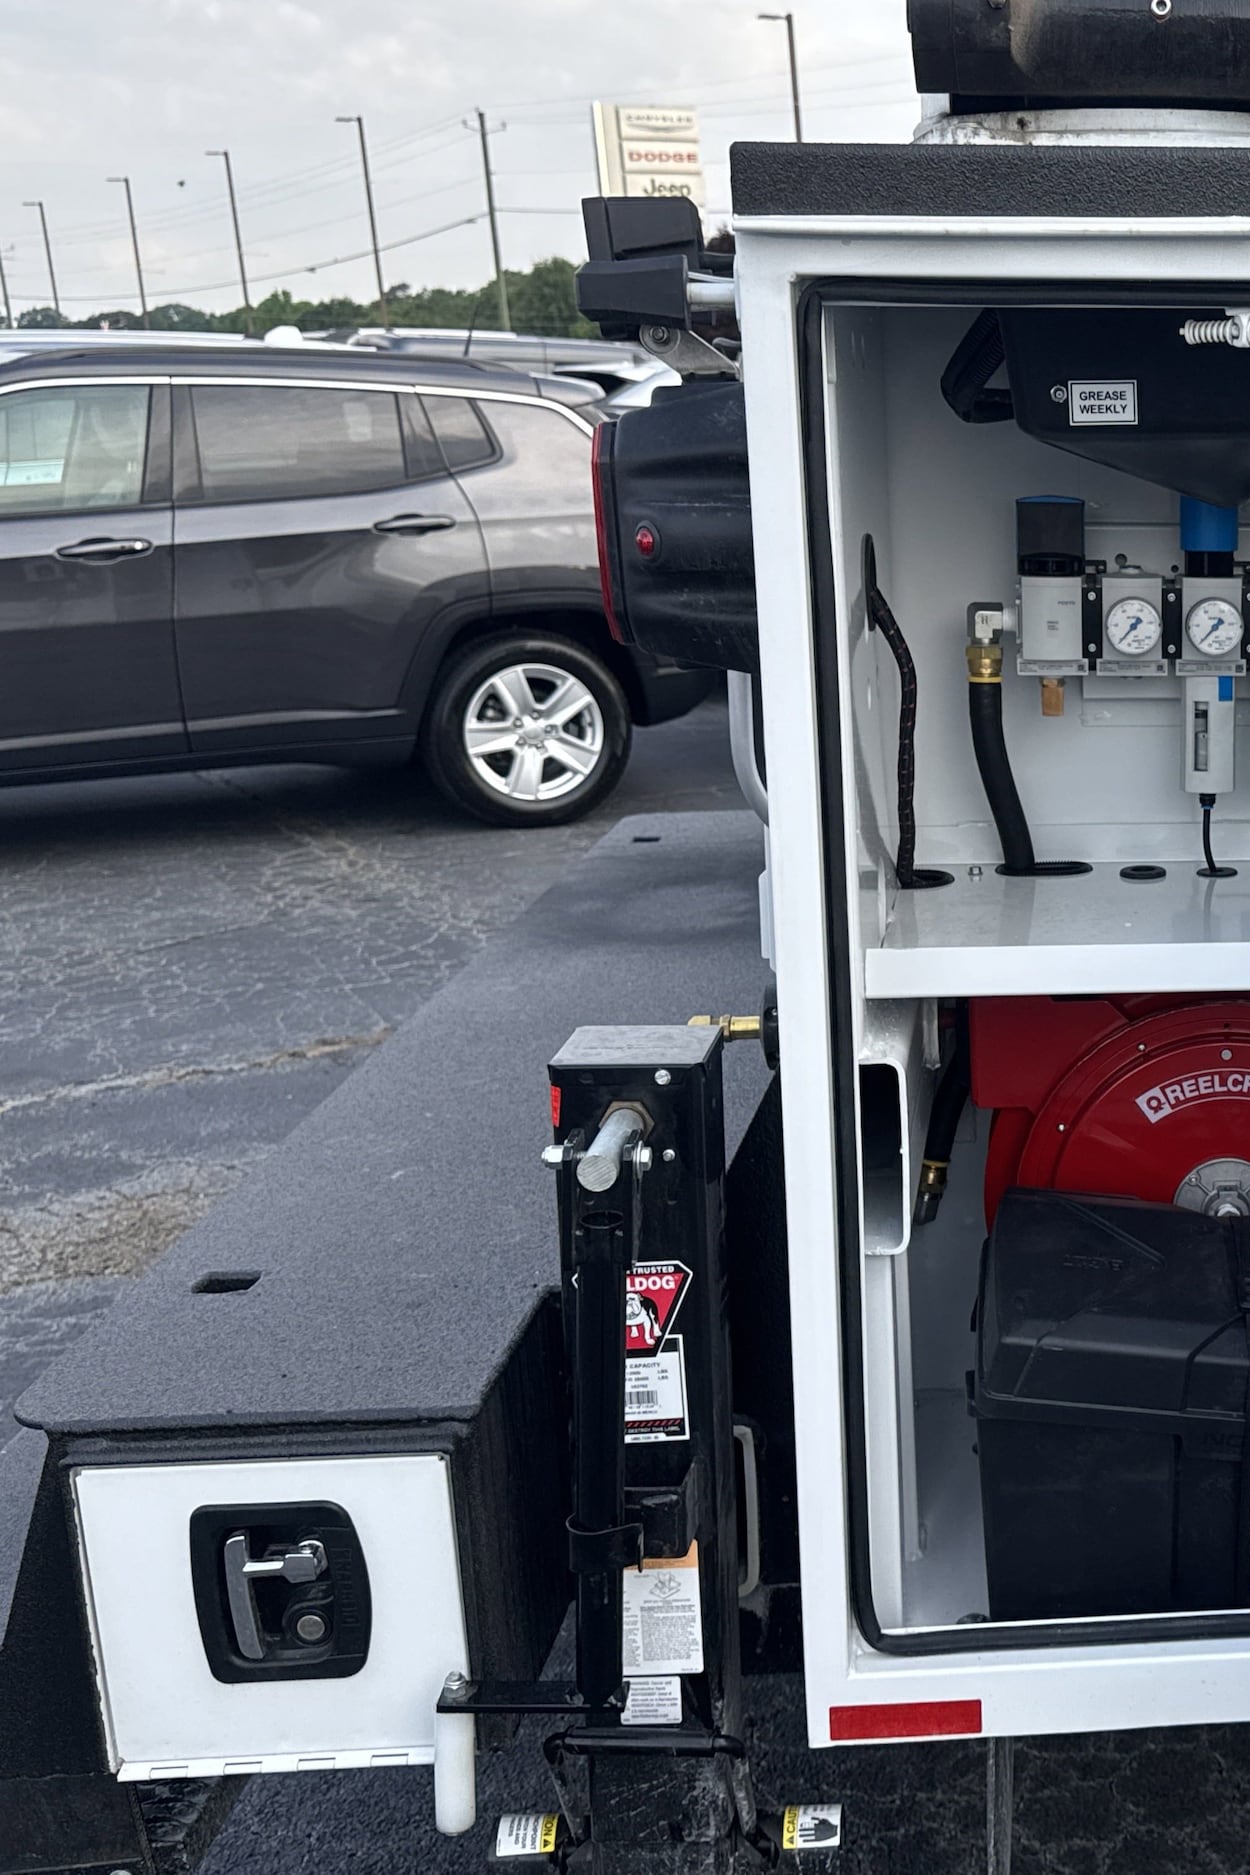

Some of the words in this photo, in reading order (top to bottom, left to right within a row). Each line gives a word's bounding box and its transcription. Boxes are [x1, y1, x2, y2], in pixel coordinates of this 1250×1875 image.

[628, 152, 698, 163] DODGE
[643, 178, 692, 197] Jeep
[1079, 390, 1127, 401] GREASE
[1079, 403, 1128, 414] WEEKLY
[632, 1266, 675, 1274] TRUSTED
[626, 1276, 676, 1291] LDOG
